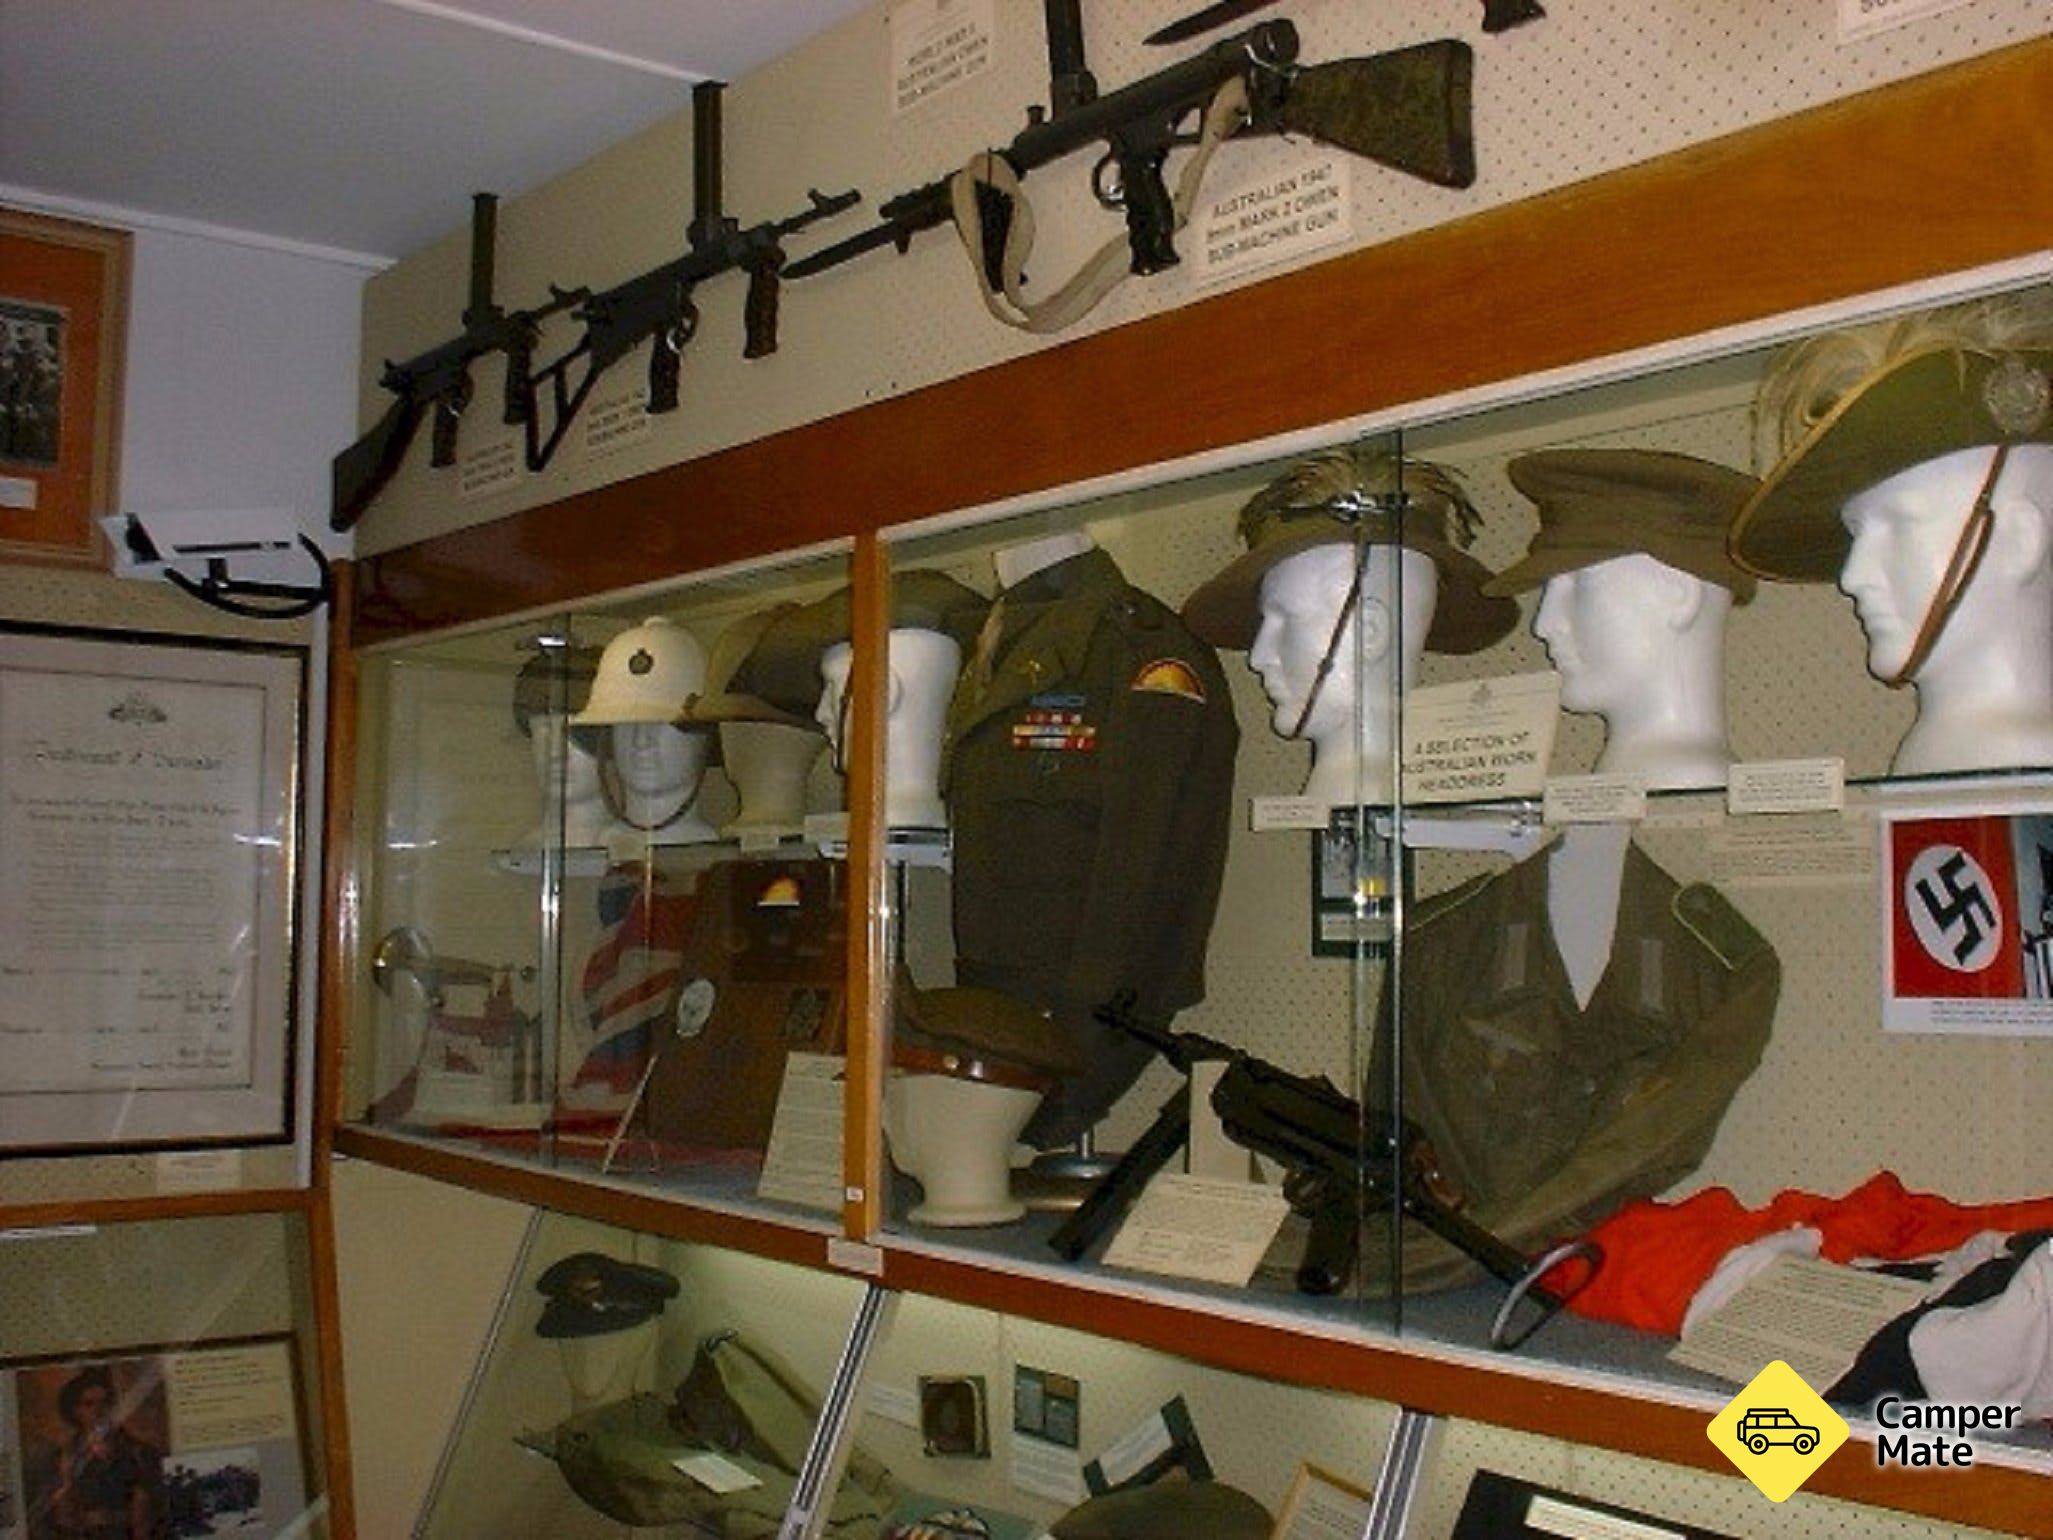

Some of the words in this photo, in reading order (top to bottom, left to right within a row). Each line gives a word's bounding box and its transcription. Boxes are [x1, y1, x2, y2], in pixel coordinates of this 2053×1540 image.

[1212, 178, 1298, 218] AUSTRALIAN
[1239, 205, 1279, 231] MARK
[1294, 184, 1339, 213] OWEN
[1305, 206, 1339, 232] GUN
[1425, 734, 1505, 755] SELECTION
